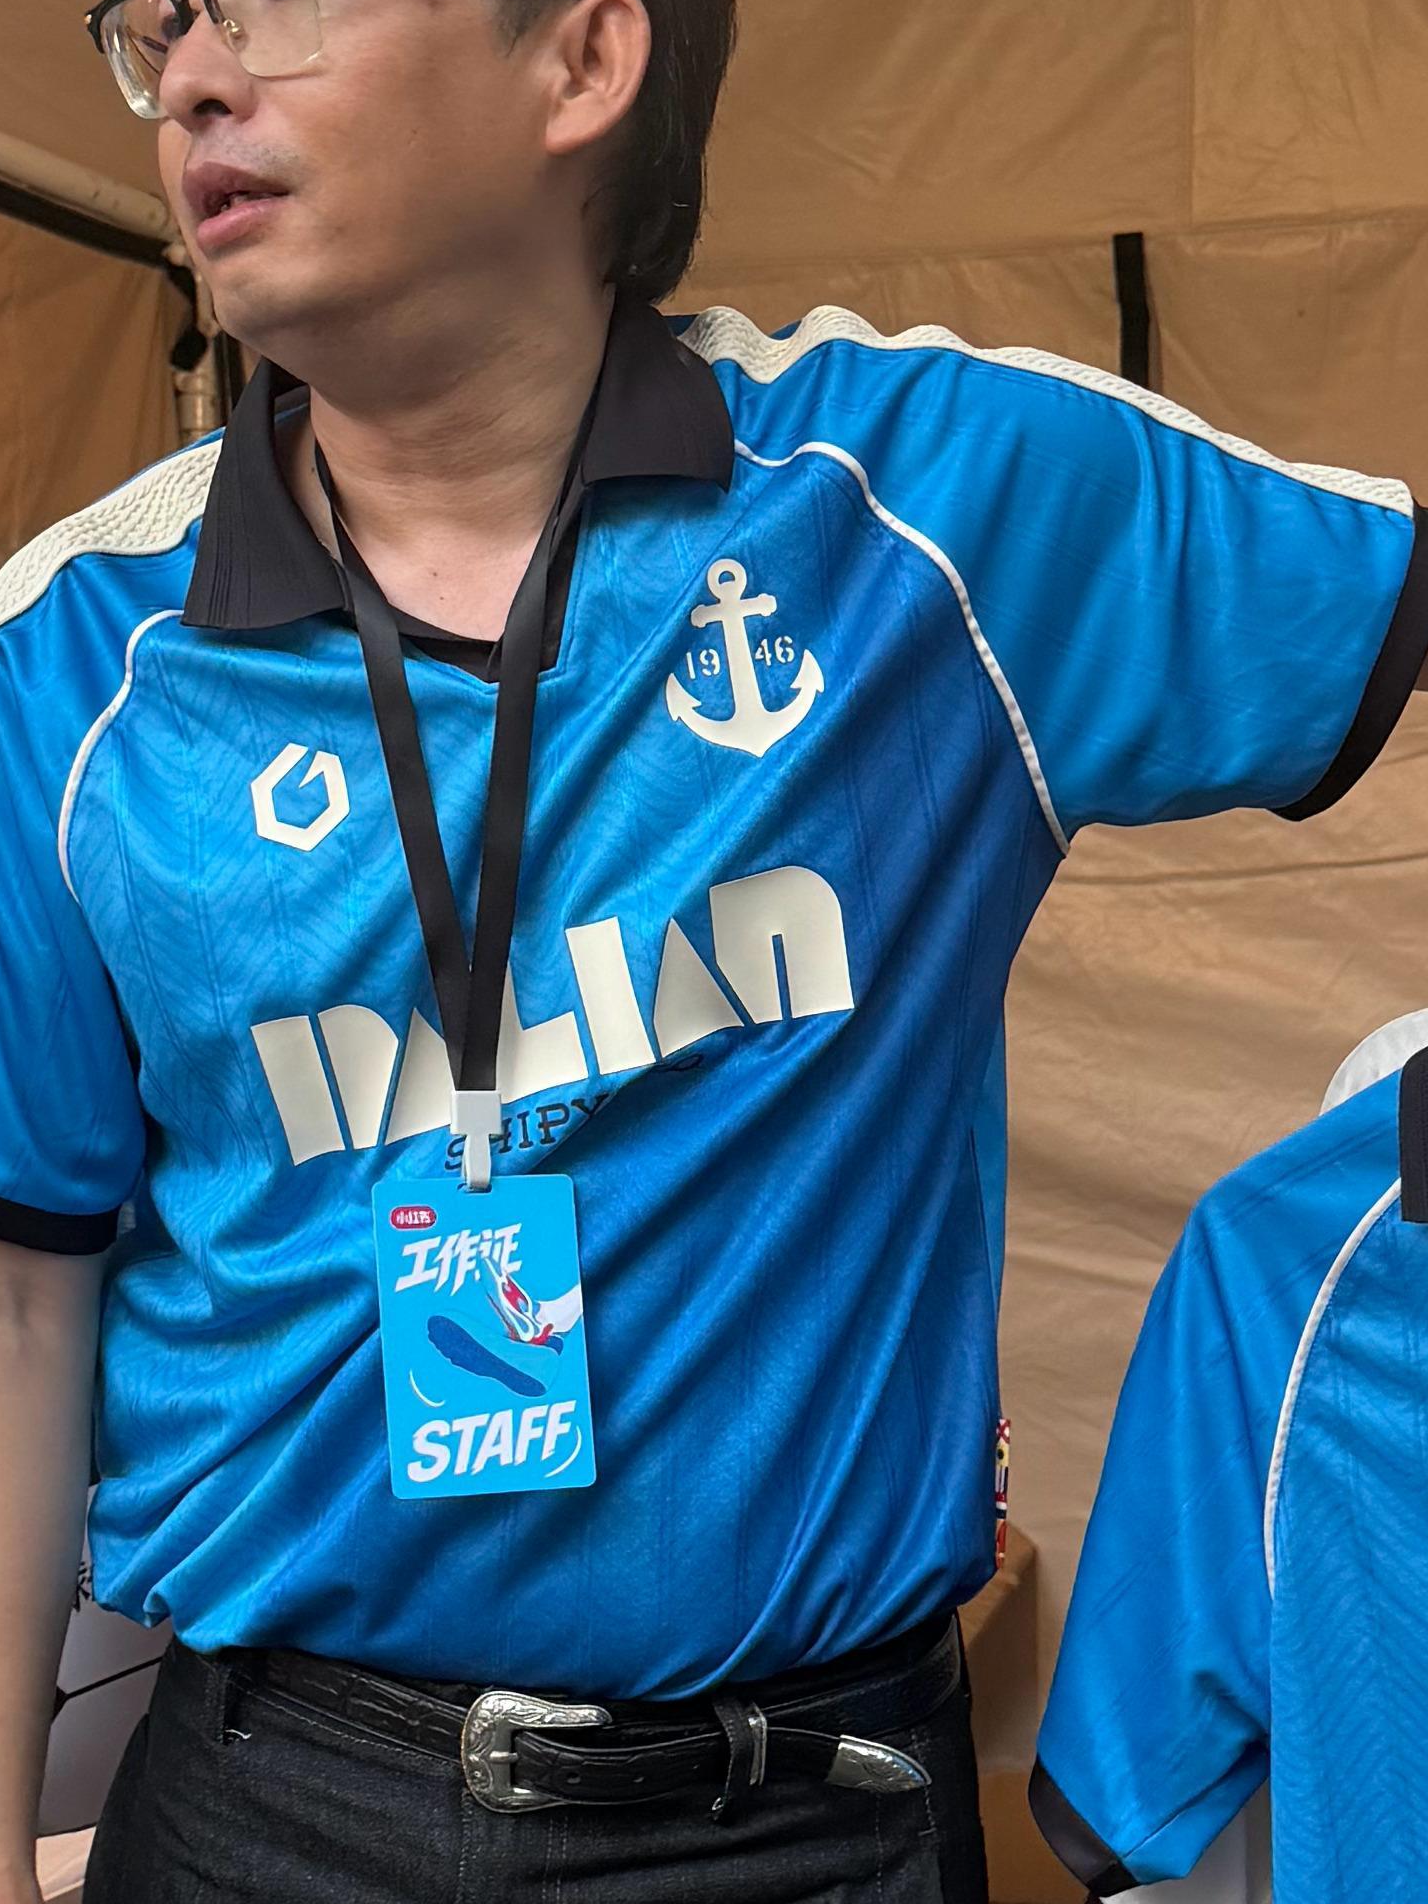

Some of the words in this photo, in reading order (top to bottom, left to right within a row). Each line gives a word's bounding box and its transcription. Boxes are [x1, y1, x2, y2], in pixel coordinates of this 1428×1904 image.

[685, 648, 721, 680] 19
[754, 635, 796, 667] 46
[406, 1399, 577, 1484] STAFF
